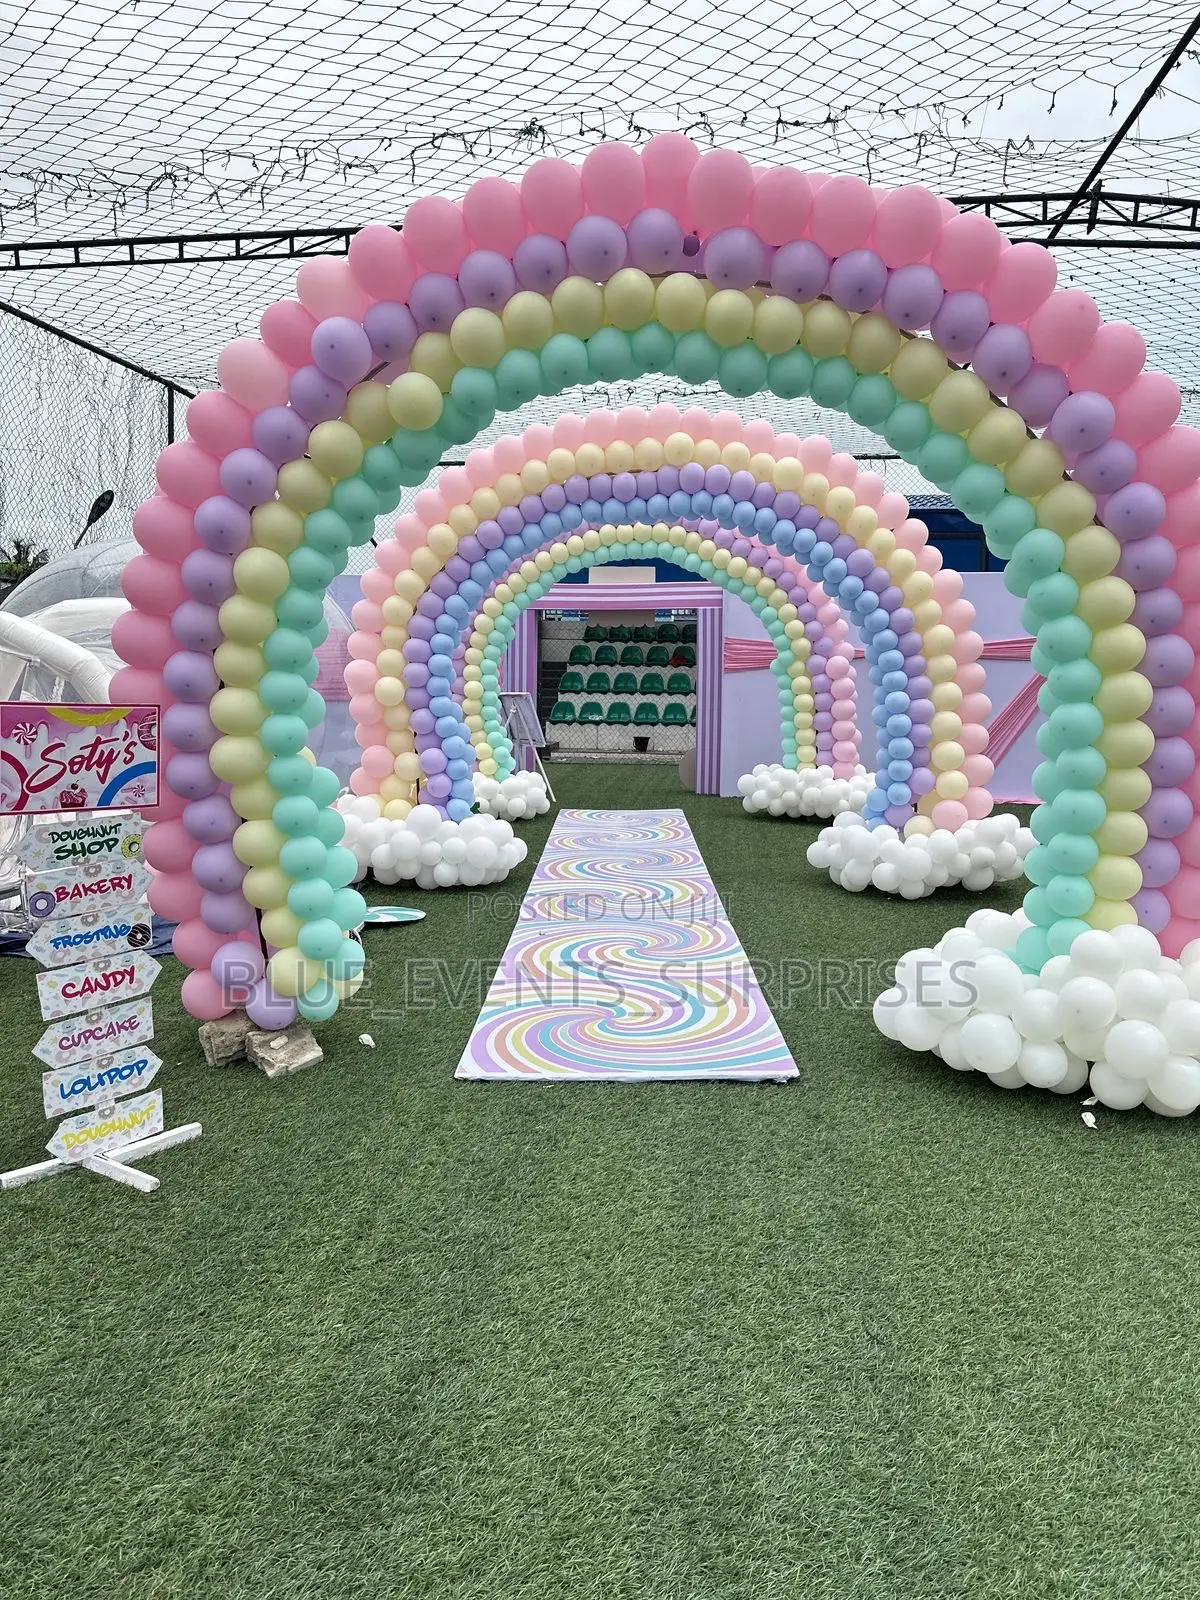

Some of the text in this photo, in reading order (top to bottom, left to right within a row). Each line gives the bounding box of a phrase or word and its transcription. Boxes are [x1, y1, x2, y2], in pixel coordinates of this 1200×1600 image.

[25, 730, 138, 794] Soty's
[48, 823, 122, 844] DOUGHNUT
[53, 837, 120, 861] SHOP
[54, 873, 133, 903] BAKERY
[50, 923, 132, 950] FROSTING
[61, 965, 136, 999] CANDY
[58, 1014, 140, 1051] CUPCAKE
[59, 1059, 149, 1100] LOLIPOP
[61, 1102, 157, 1151] DOUGHNUT
